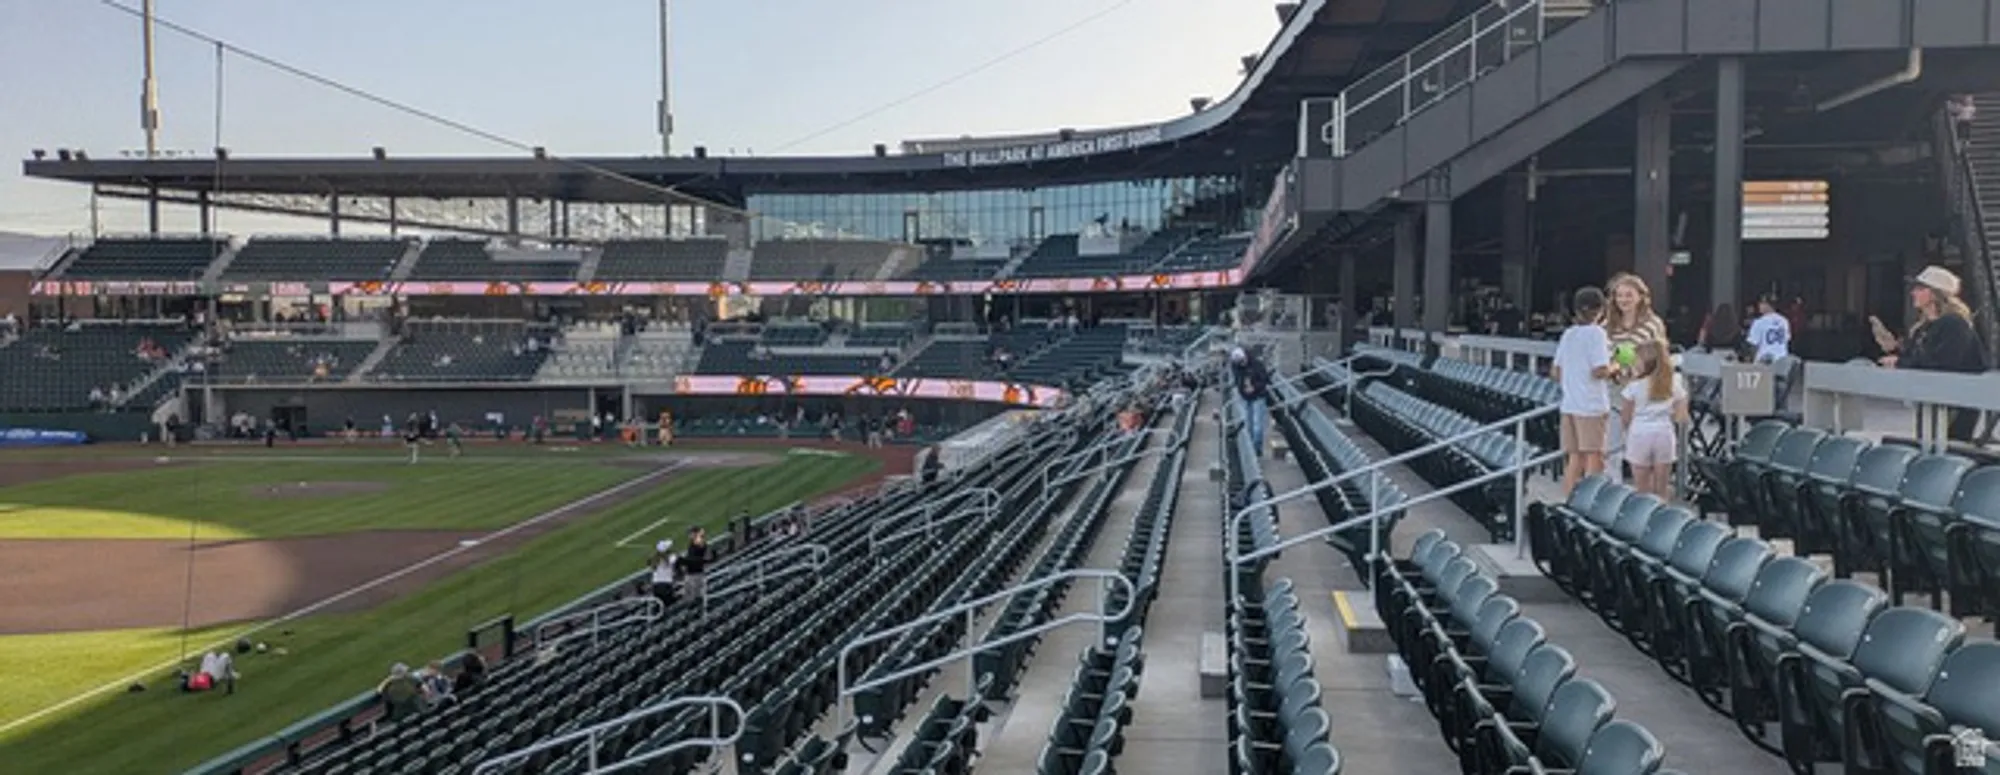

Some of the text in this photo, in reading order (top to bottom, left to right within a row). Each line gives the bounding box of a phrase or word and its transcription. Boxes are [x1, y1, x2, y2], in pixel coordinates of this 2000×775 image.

[943, 152, 966, 167] THE
[970, 147, 1026, 167] BALLPARK
[1031, 144, 1046, 161] AT
[1047, 140, 1095, 159] AMERICA
[1097, 133, 1123, 153] FIRST
[1737, 372, 1762, 390] 117
